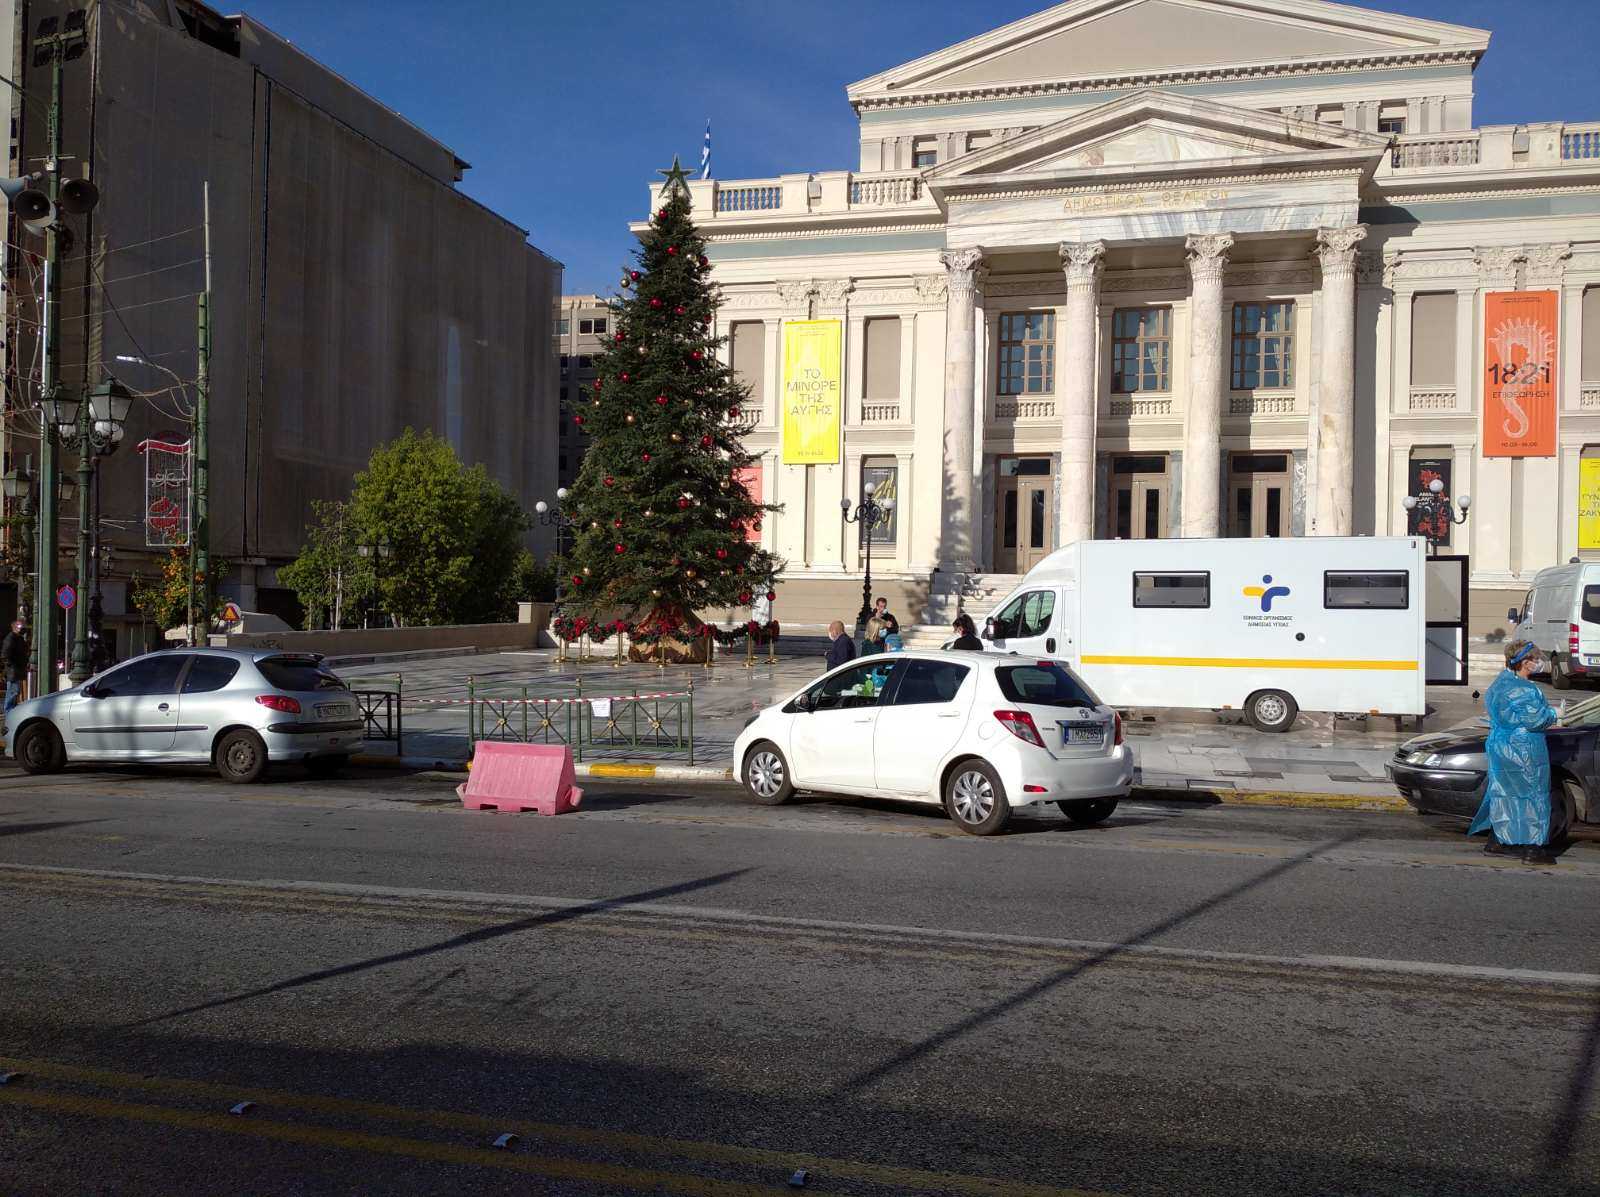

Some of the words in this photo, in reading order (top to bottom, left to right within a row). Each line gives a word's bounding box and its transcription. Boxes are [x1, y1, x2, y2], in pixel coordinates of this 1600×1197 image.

[804, 368, 821, 379] ΤΟ
[1488, 361, 1550, 384] 1821
[786, 380, 837, 392] ΜΙΝΟΡΕ
[799, 392, 825, 403] ΤΗΣ
[790, 404, 833, 416] ΑΥΓΗΣ
